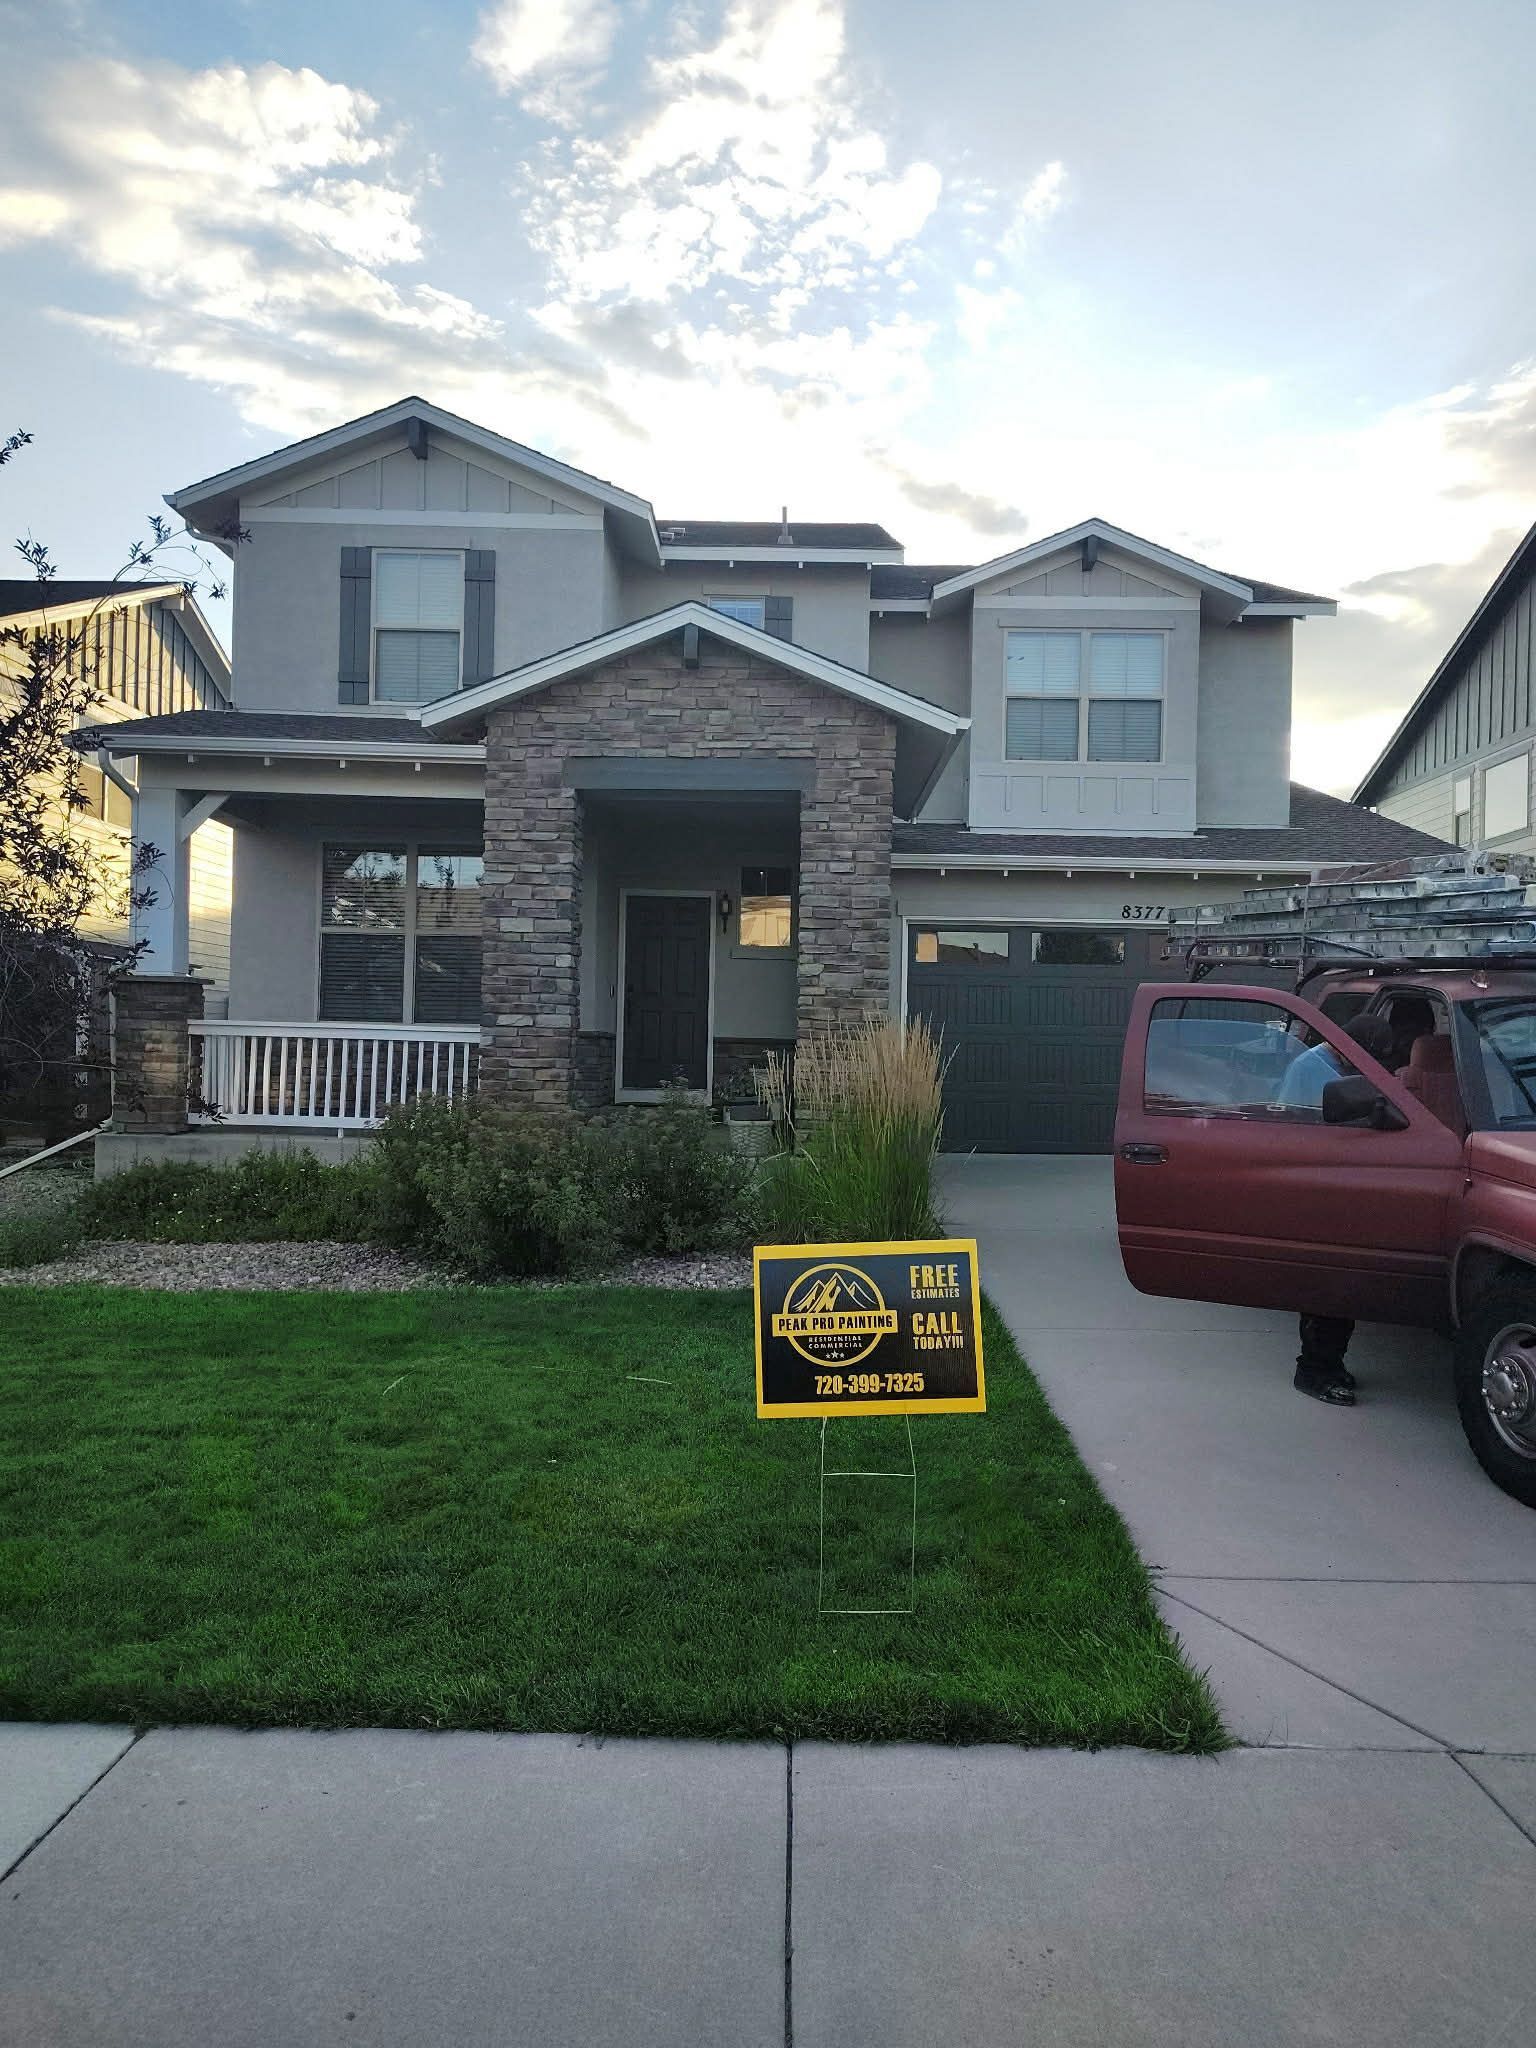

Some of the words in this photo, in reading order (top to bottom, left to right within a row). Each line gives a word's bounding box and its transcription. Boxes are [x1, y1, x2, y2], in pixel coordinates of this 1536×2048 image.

[1121, 904, 1166, 920] 8377
[909, 1264, 959, 1288] FREE
[911, 1288, 960, 1299] ESTIMATES
[778, 1317, 808, 1331] PEAK
[812, 1316, 834, 1330] PRO
[838, 1315, 893, 1329] PAINTING
[912, 1311, 963, 1335] CALL
[808, 1335, 862, 1343] RESIDENTIAL
[913, 1335, 964, 1350] TODAY!!!
[814, 1373, 925, 1395] 720-399-7325
